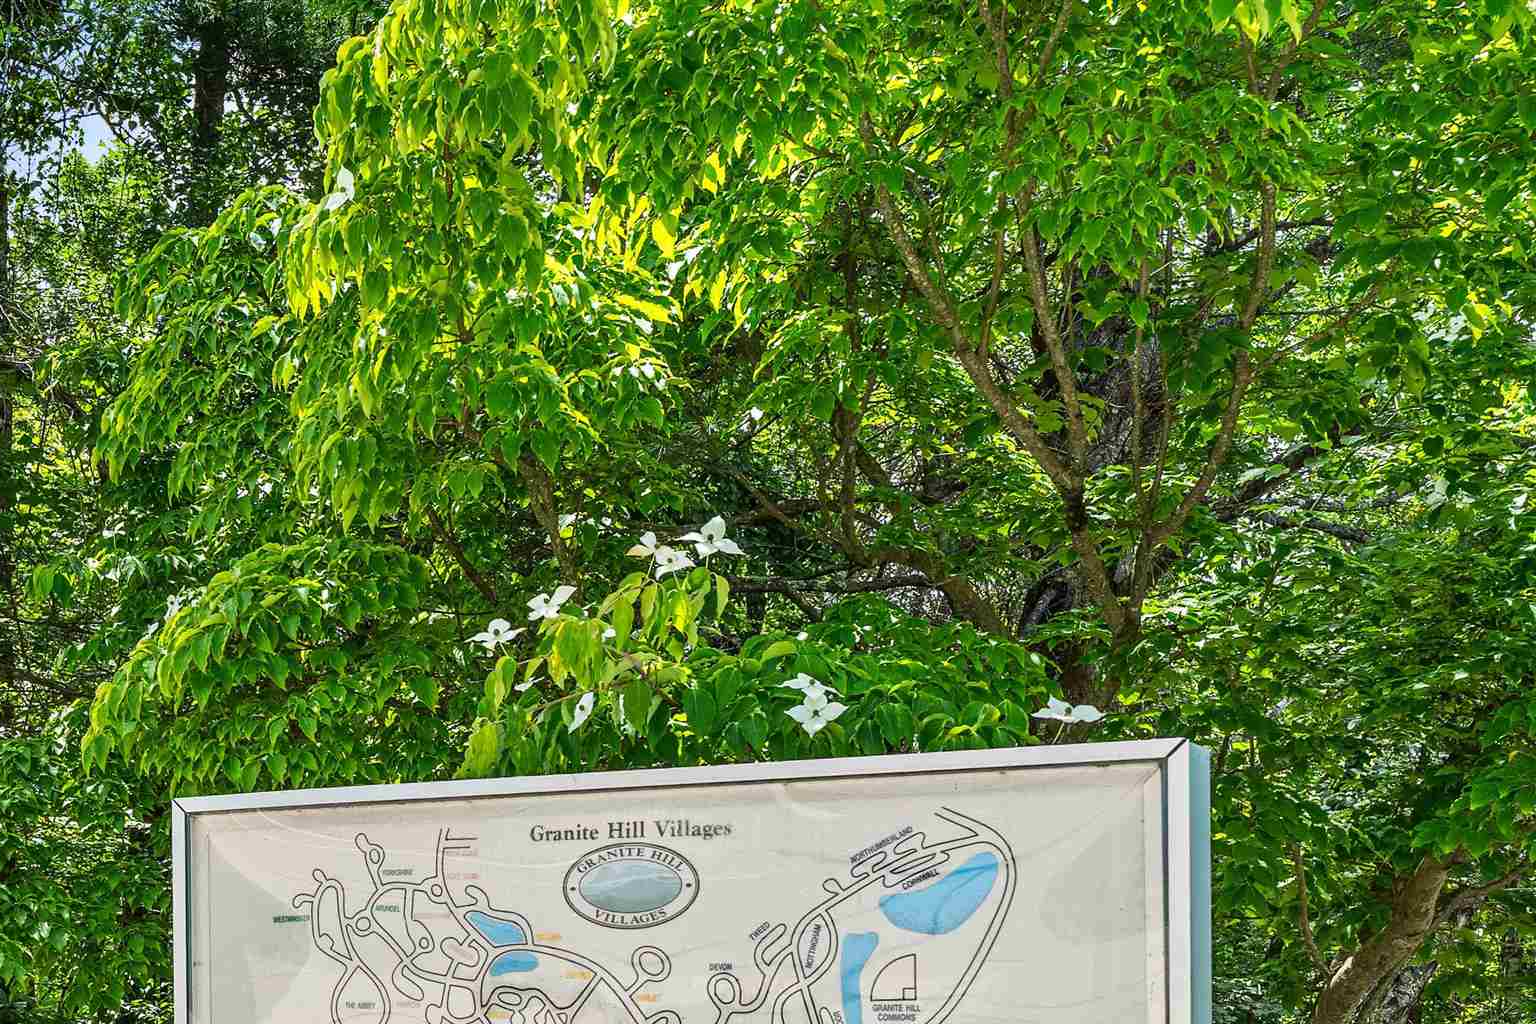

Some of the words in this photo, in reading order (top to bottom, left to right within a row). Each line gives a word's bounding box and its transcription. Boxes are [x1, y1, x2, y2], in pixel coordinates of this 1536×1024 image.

[529, 824, 600, 842] Granite
[607, 821, 646, 839] Hill
[654, 819, 733, 841] Villages
[849, 825, 914, 864] NORTHUMBERLAND
[575, 847, 646, 875] GRANITE
[650, 849, 686, 873] HILL
[902, 868, 940, 890] CORNWALL
[593, 908, 669, 926] VILLAGES
[749, 920, 770, 940] TWEED
[709, 962, 733, 971] DEVON
[872, 1004, 904, 1013] GRANITE
[905, 1004, 921, 1013] HILL
[877, 1013, 917, 1022] COMMONS
